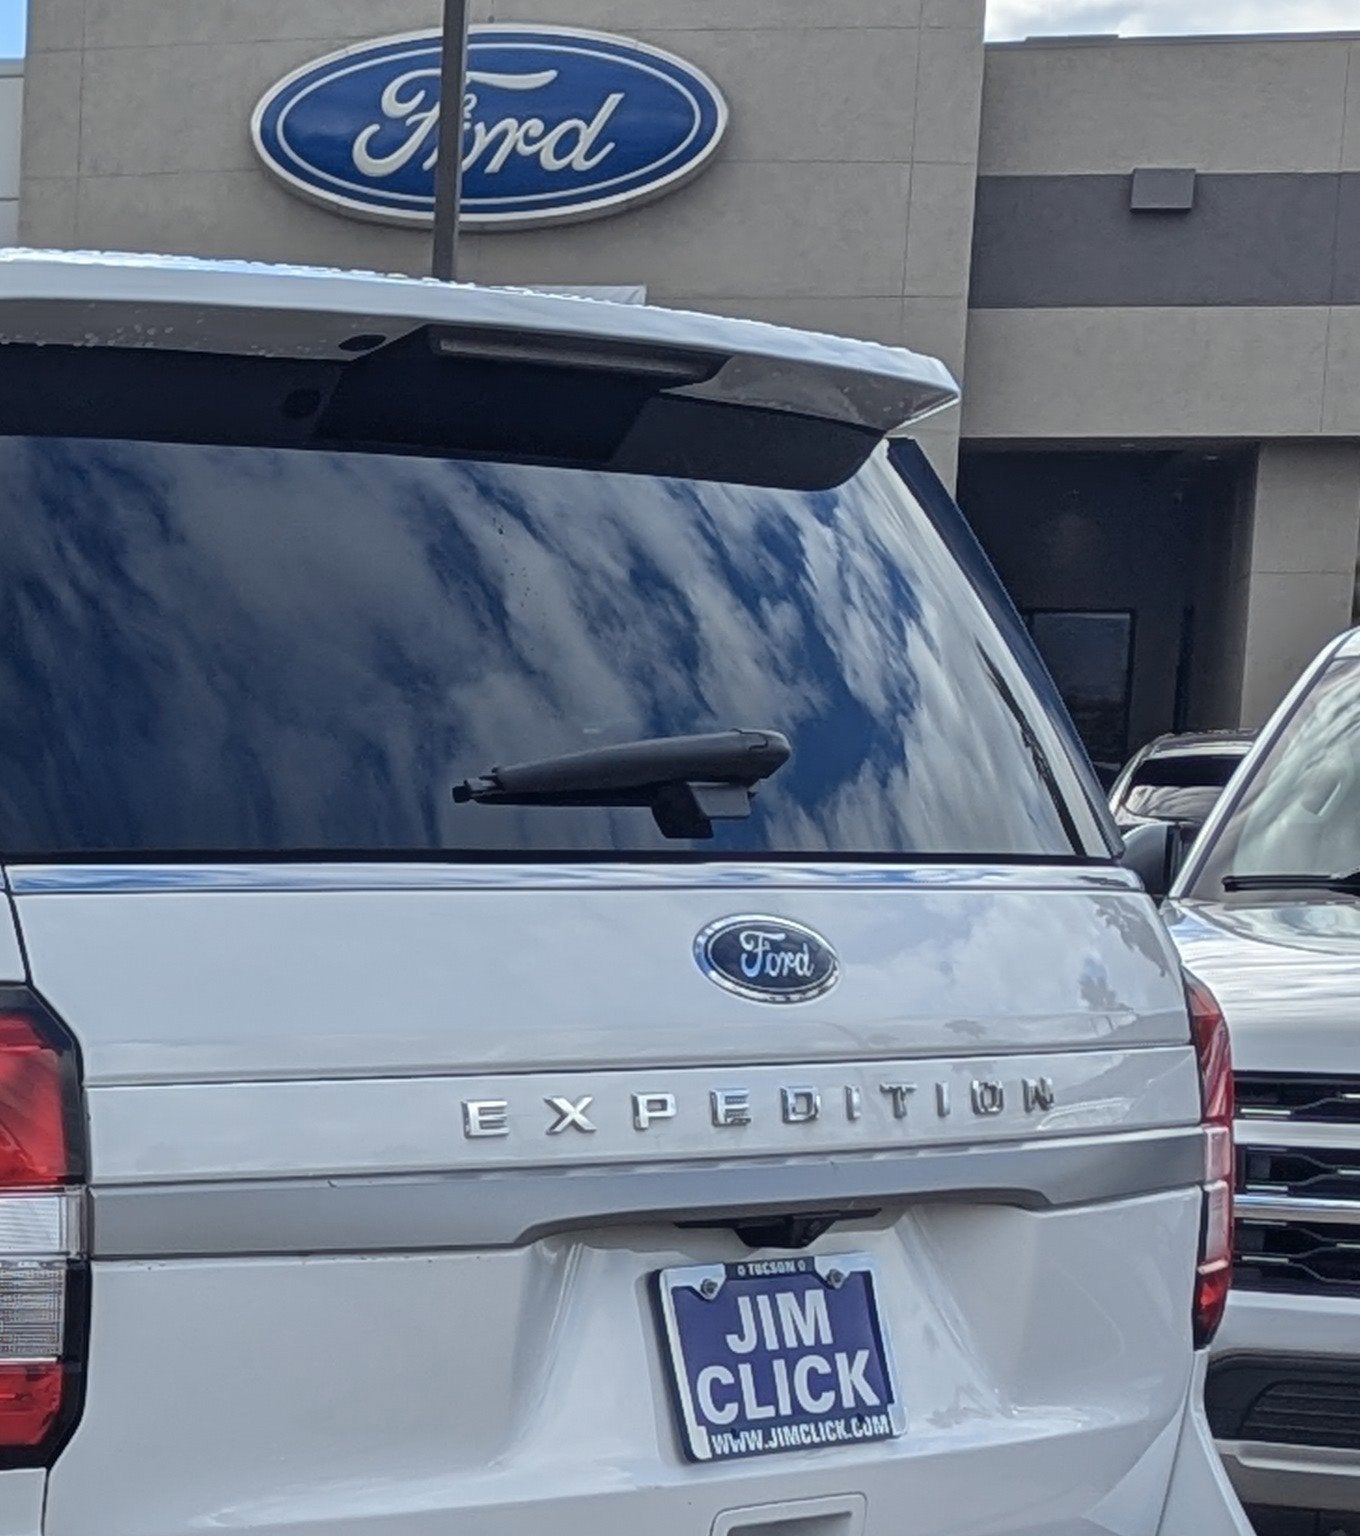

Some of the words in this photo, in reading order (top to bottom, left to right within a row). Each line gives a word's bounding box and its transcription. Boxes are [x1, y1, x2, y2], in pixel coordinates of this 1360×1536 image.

[739, 930, 815, 978] Ford
[461, 1075, 1055, 1139] EXPEDITION
[747, 1259, 797, 1276] TUCSON
[726, 1288, 833, 1354] JIM
[696, 1349, 881, 1425] CLICK
[711, 1413, 891, 1455] WWW.JIMCLICK.COM
